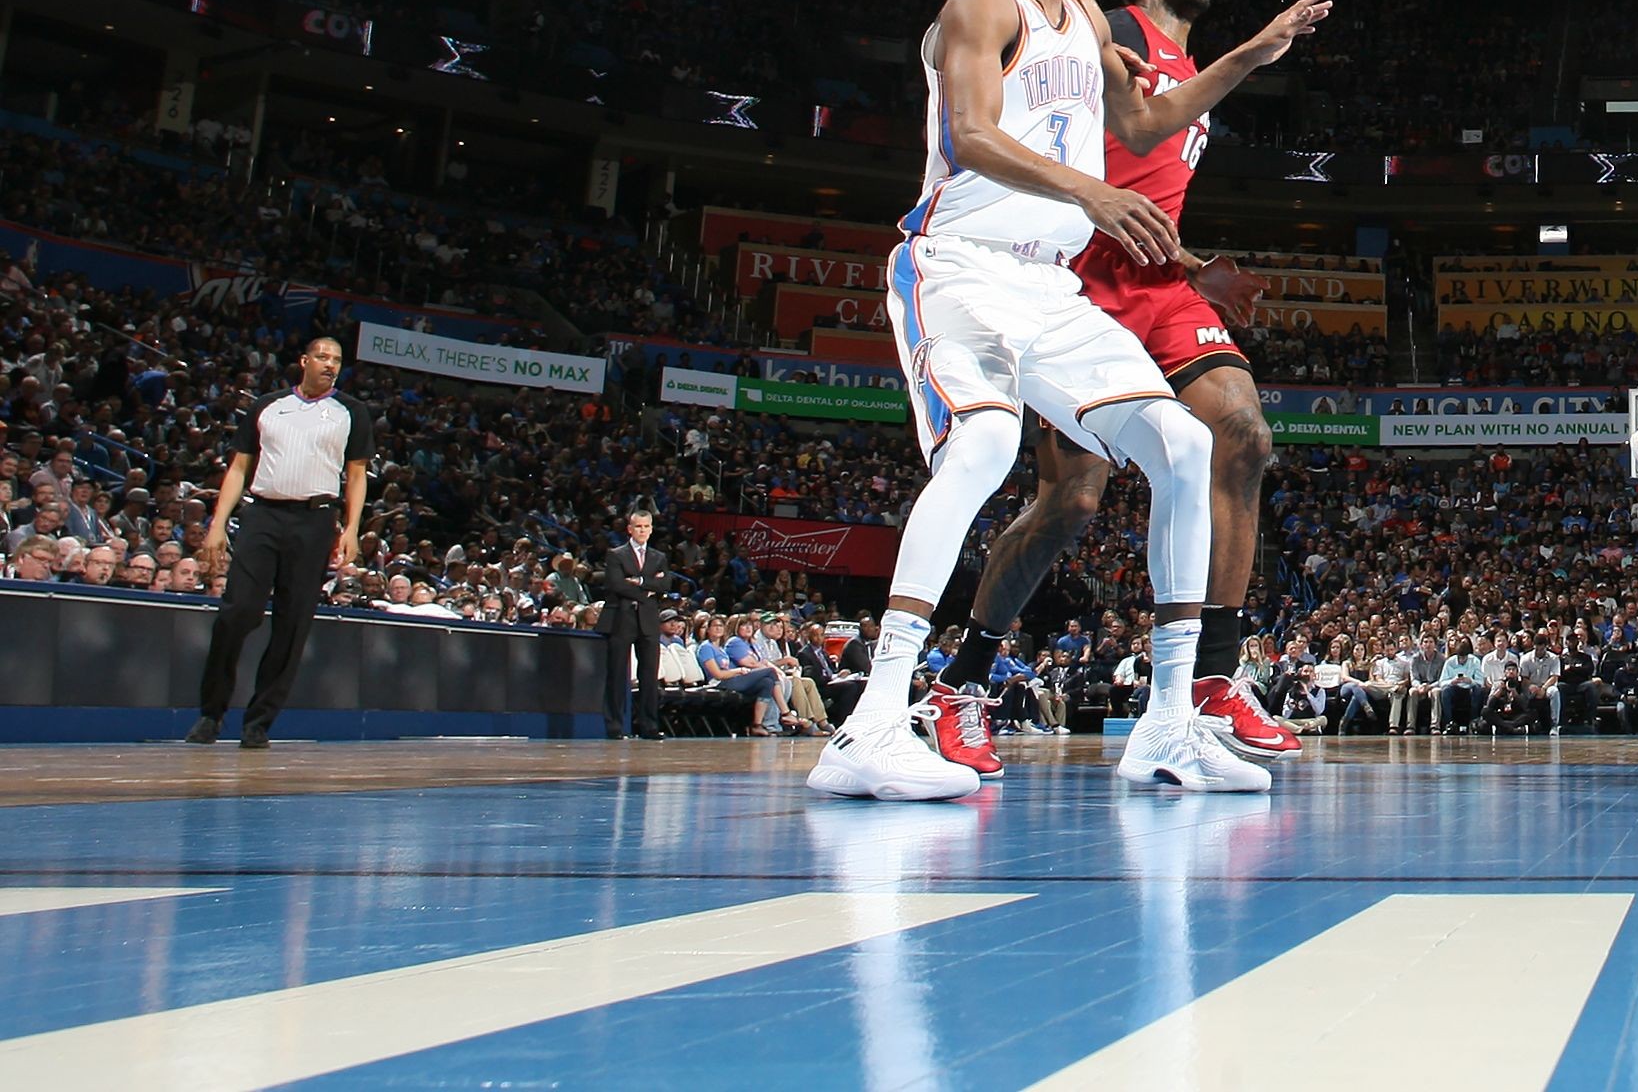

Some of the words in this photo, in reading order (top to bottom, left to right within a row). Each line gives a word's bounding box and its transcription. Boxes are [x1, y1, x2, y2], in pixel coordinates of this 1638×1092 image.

[1048, 110, 1072, 166] 3
[1181, 124, 1208, 171] 16
[1489, 310, 1630, 331] CASINO
[372, 336, 430, 363] RELAX,
[436, 348, 507, 374] THERE'S
[513, 360, 543, 376] NO
[549, 364, 591, 382] MAX
[766, 393, 793, 404] DELTA
[796, 395, 833, 406] DENTAL
[836, 398, 849, 407] OF
[851, 399, 904, 411] OKLAHOMA
[1260, 390, 1282, 404] 20
[1288, 424, 1322, 434] DELTA
[1324, 424, 1368, 435] DENTAL
[1393, 425, 1431, 436] NEW
[1435, 424, 1475, 436] PLAN
[1480, 424, 1521, 435] WITH
[1526, 423, 1549, 435] NO
[1554, 423, 1619, 435] ANNUAL
[741, 528, 838, 556] Budweiser
